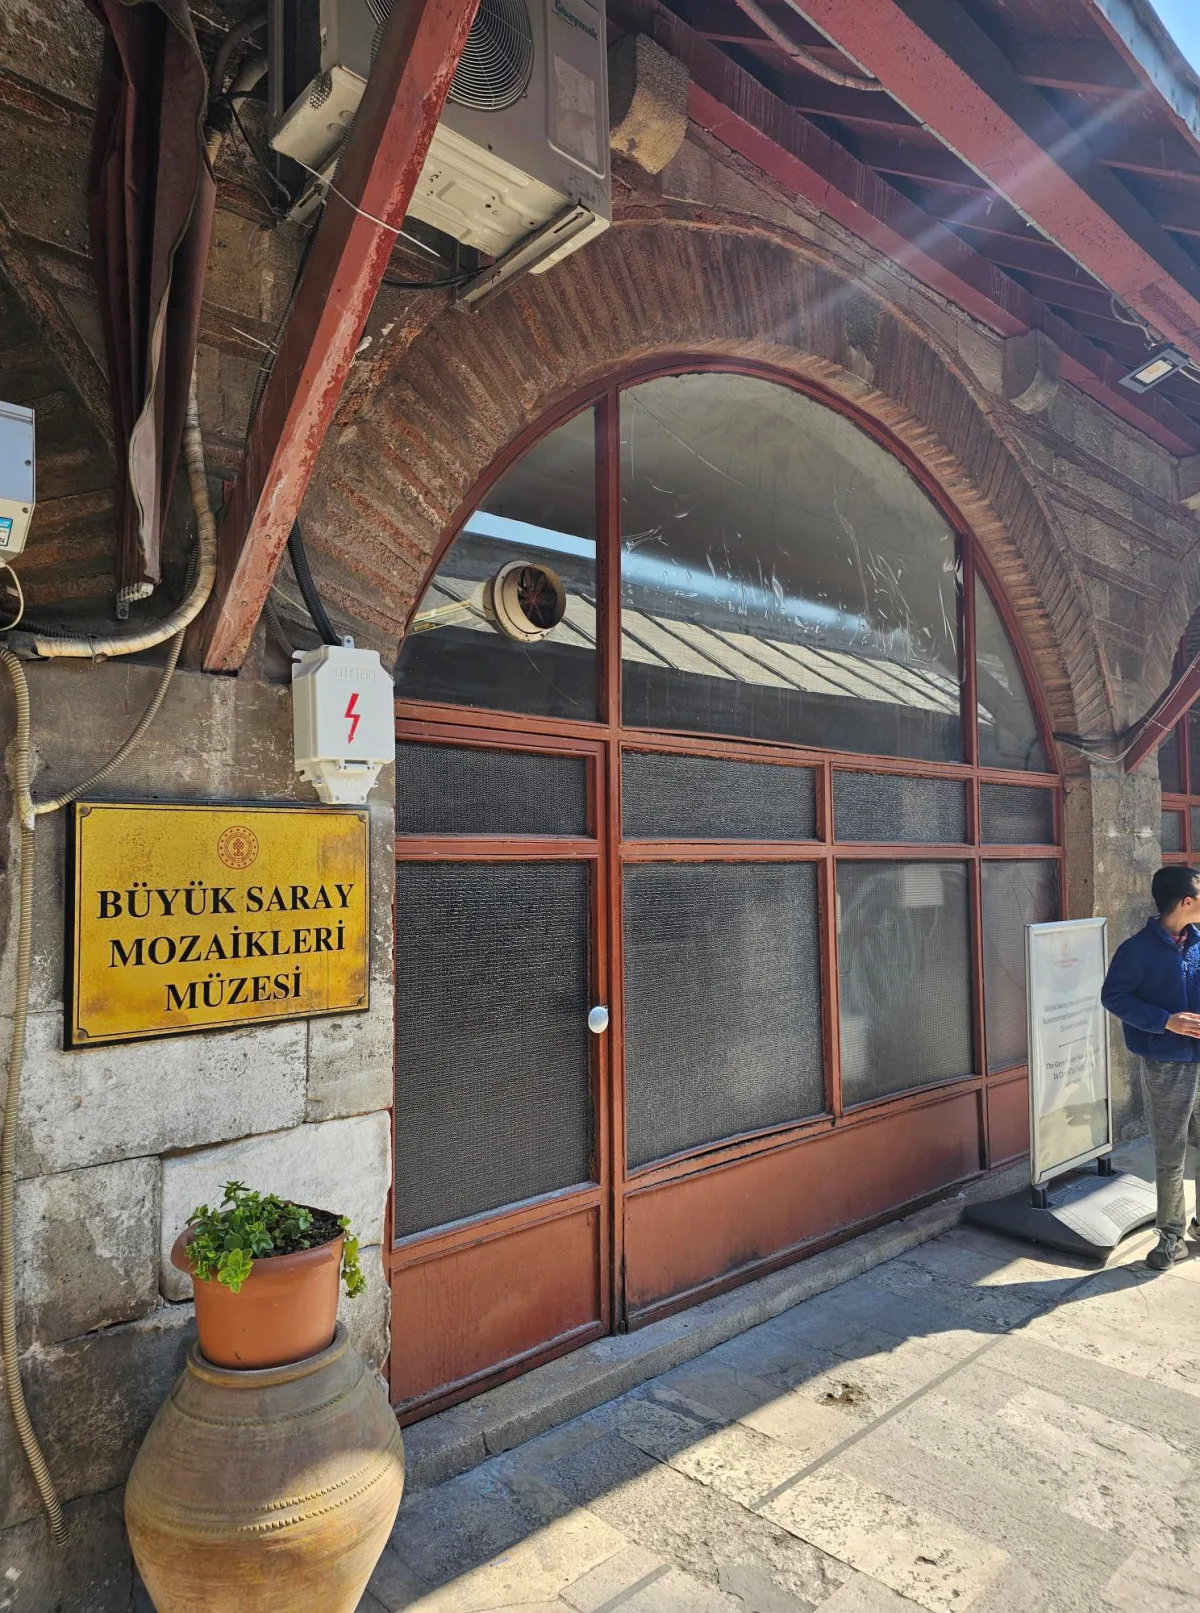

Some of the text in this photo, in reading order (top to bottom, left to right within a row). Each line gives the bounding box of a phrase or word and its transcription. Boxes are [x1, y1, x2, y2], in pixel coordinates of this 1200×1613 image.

[97, 880, 354, 919] BÜYÜK SARAY
[108, 919, 346, 968] MOZAİKLERİ
[164, 965, 302, 1012] MÜZESİ
